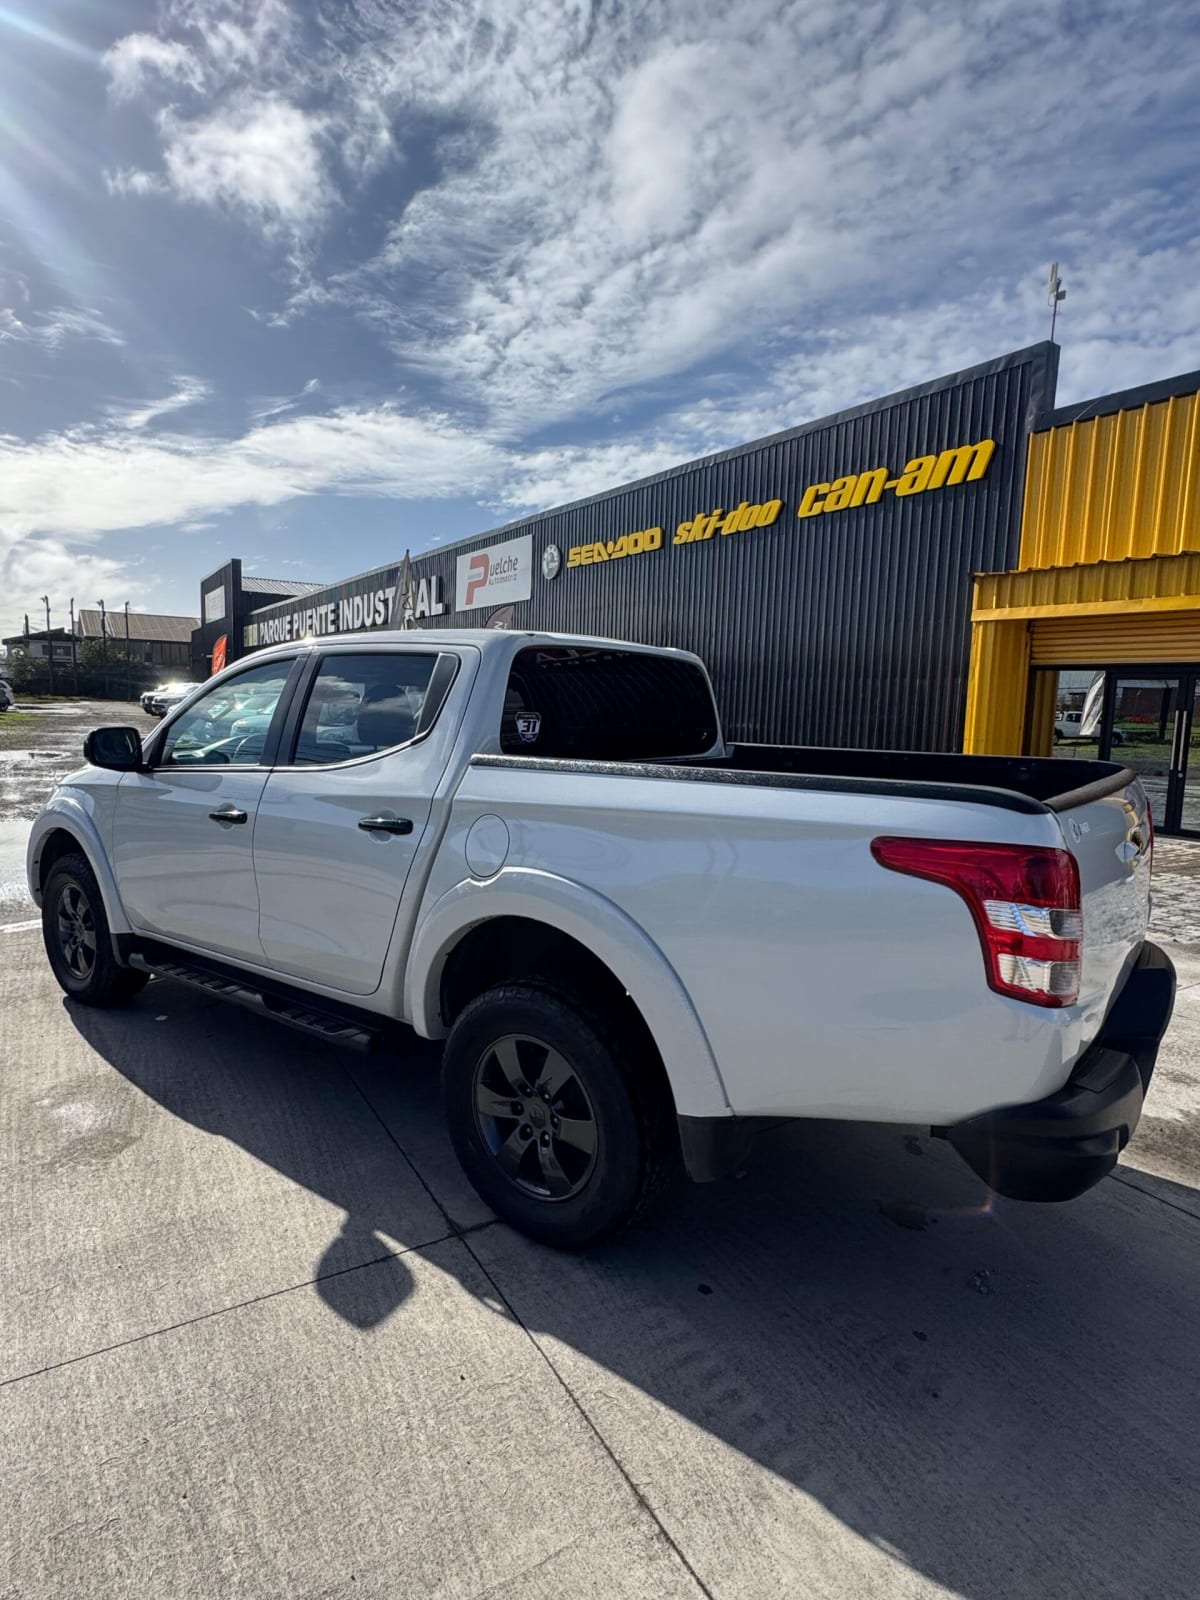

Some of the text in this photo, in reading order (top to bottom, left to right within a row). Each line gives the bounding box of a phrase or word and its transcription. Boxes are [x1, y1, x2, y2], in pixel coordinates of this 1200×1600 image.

[798, 439, 996, 518] can-am
[673, 499, 783, 546] ski-doo
[465, 553, 518, 605] Puelche
[259, 576, 444, 645] PARQUE PUENTE INDUSTAL
